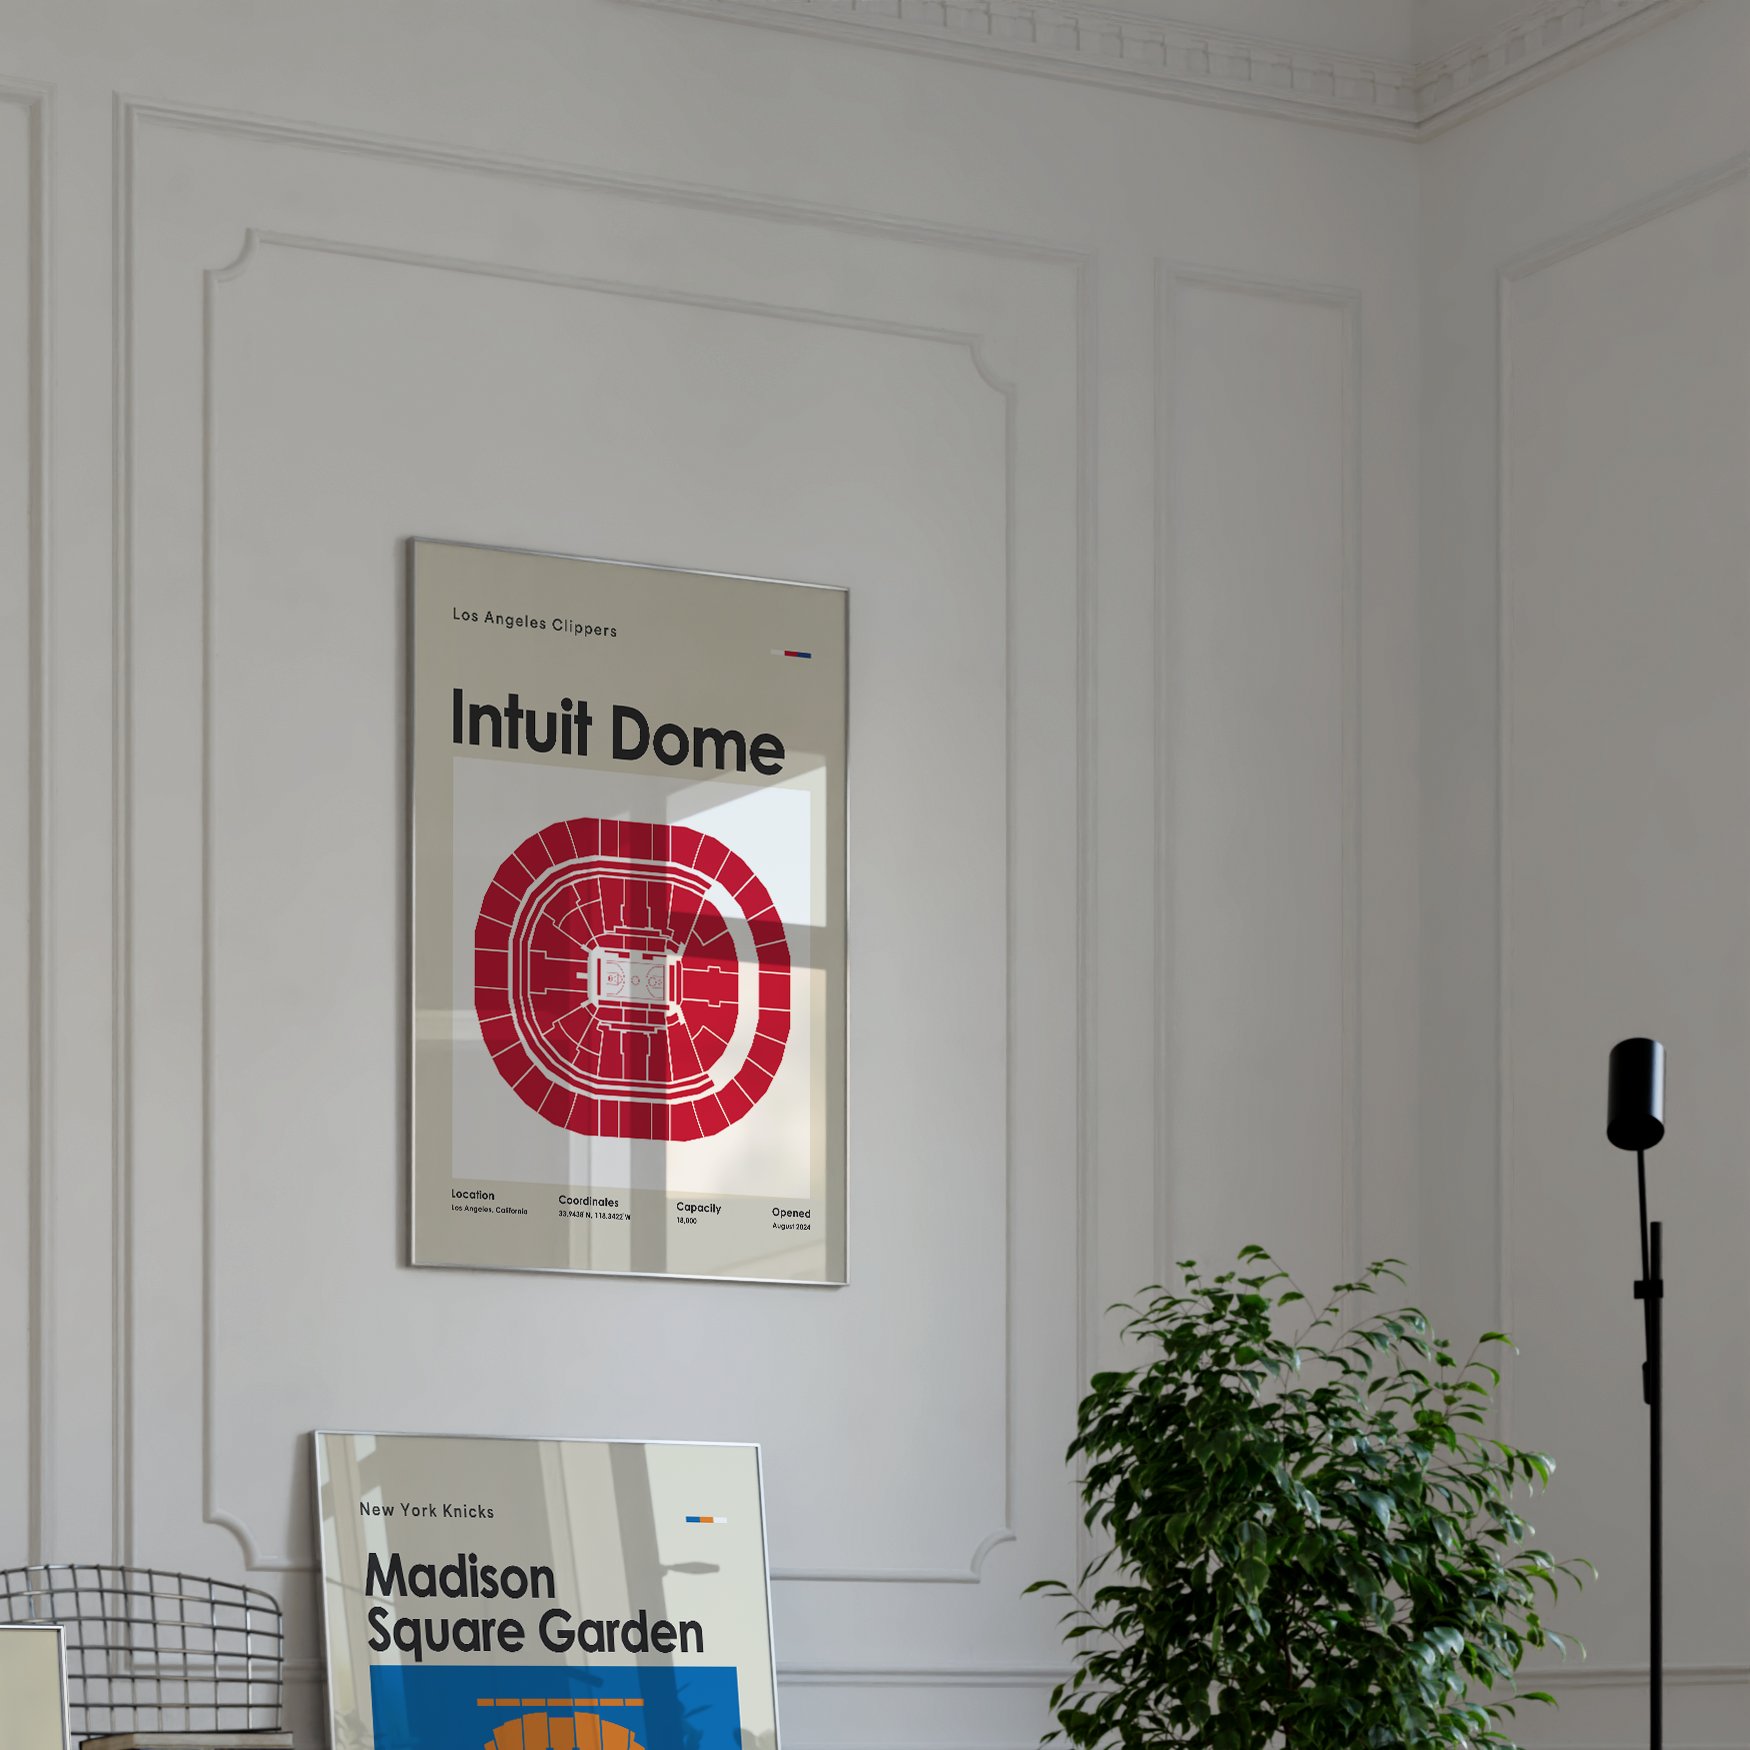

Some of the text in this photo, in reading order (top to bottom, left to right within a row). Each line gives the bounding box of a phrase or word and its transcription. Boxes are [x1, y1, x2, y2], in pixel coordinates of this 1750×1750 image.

[454, 607, 616, 637] Los Angeles Clippers
[453, 688, 785, 775] Intuit Dome
[452, 1189, 494, 1200] Location
[559, 1195, 618, 1207] Coordinates
[772, 1208, 810, 1218] Opened
[360, 1502, 493, 1518] New York Knicks
[365, 1553, 555, 1599] Madison
[368, 1607, 703, 1662] Square Garden
